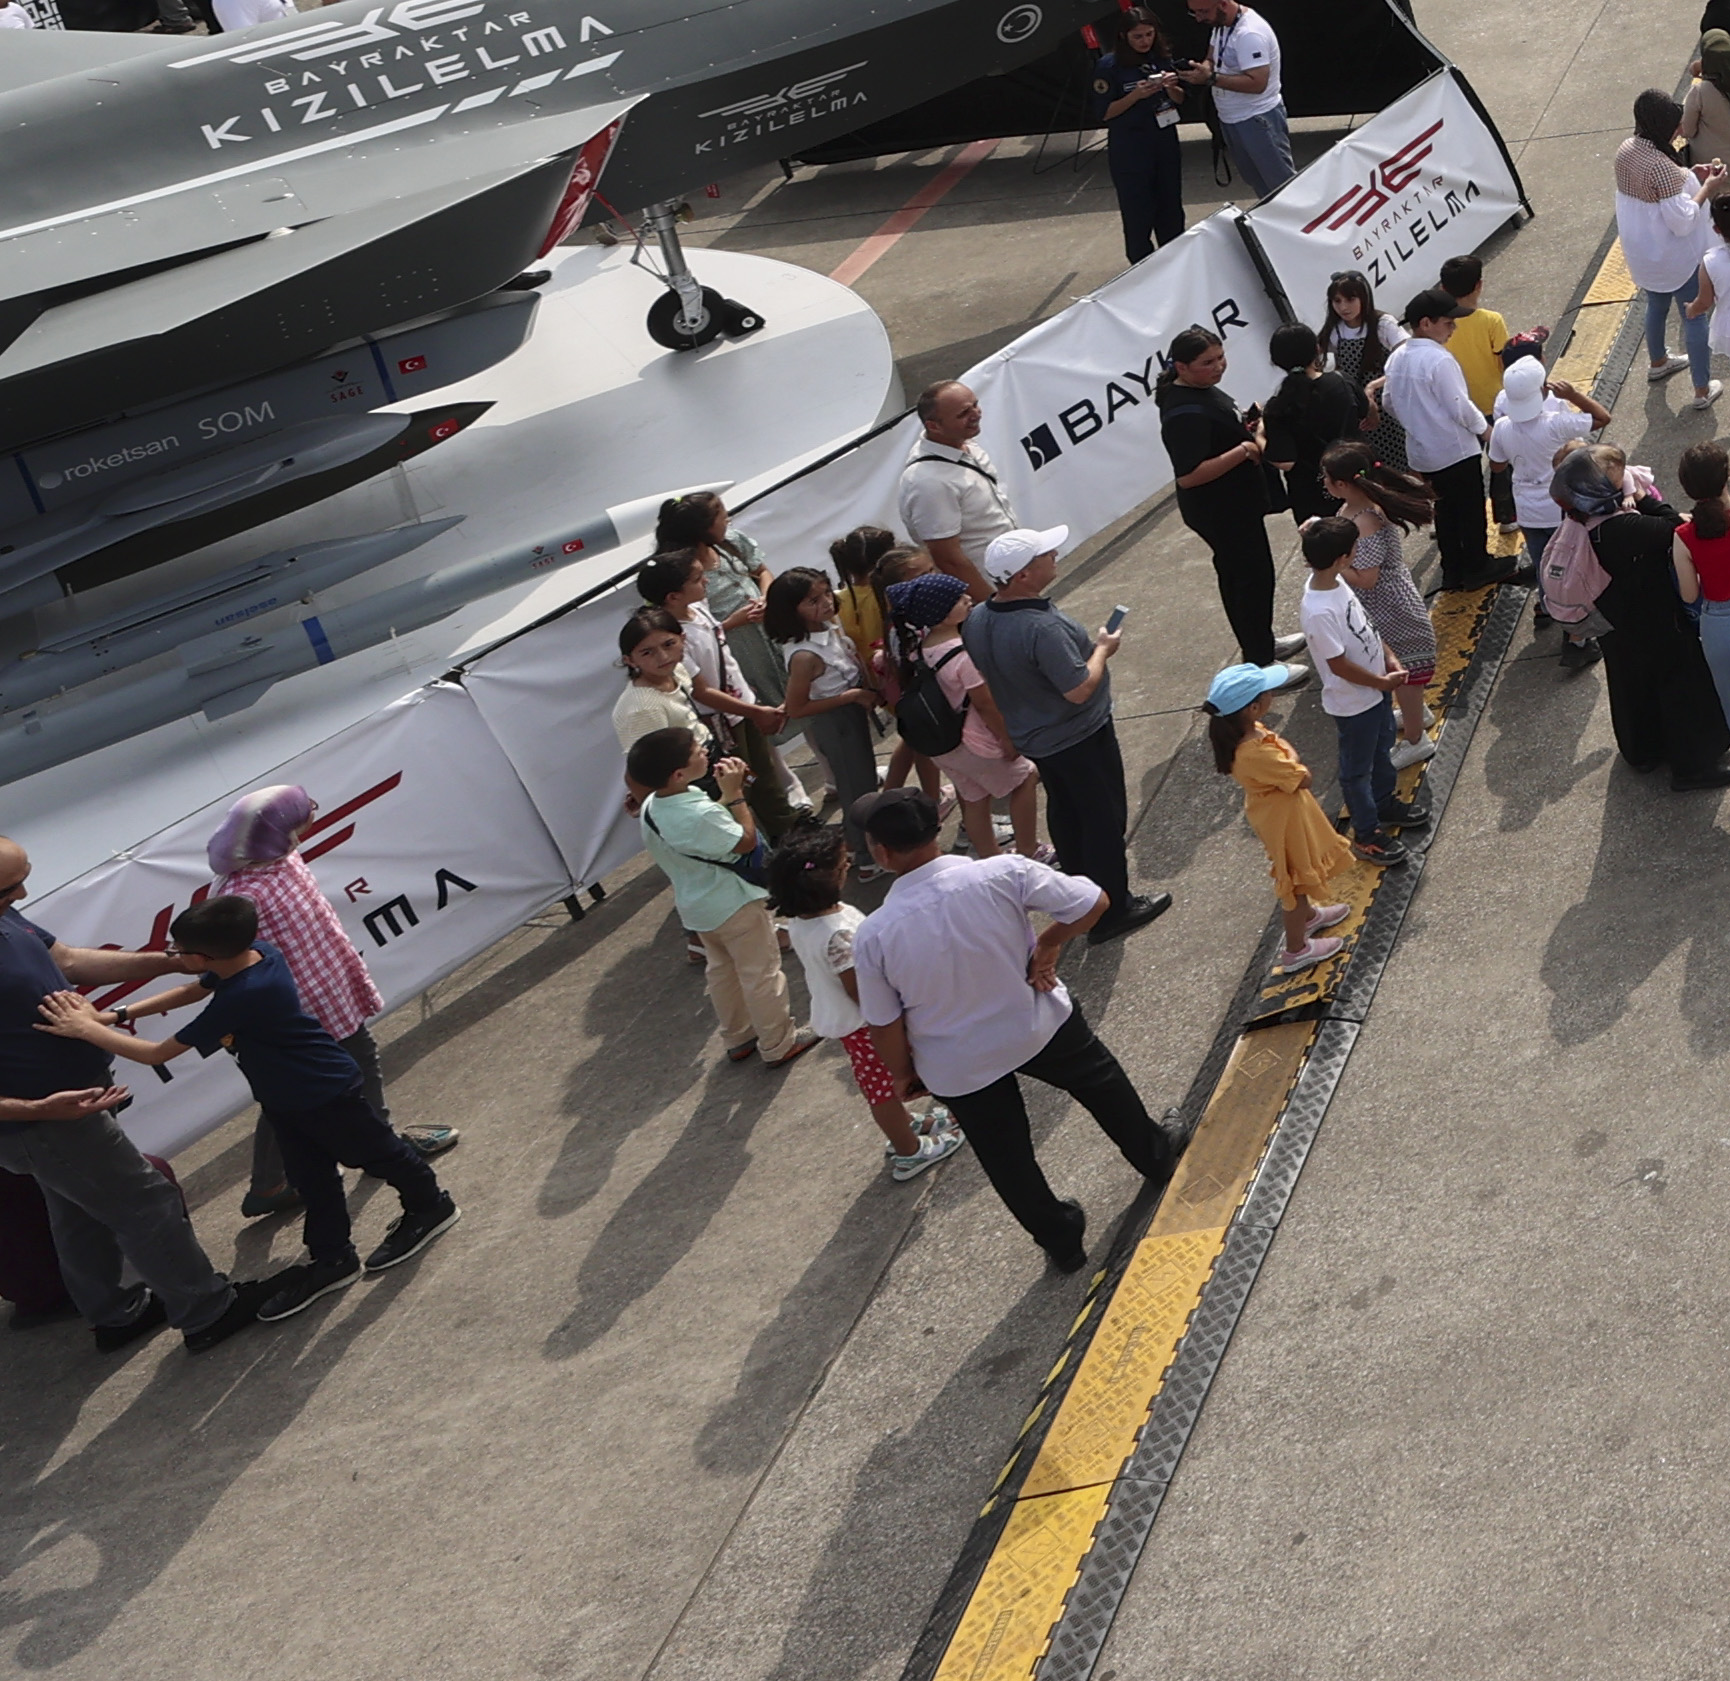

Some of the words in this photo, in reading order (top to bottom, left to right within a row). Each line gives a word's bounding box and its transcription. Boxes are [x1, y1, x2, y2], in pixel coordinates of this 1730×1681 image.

[200, 15, 614, 150] KIZILELMA
[264, 10, 532, 95] BAYRAKTAR
[695, 91, 868, 155] KIZILELMA
[727, 89, 842, 131] BAYRAKTAR
[1353, 174, 1444, 261] BAYRAKTAR
[1366, 180, 1482, 289] ZILELMA
[331, 385, 364, 404] SAGE
[1058, 298, 1250, 446] BAYR
[63, 432, 180, 485] roketsan
[197, 400, 276, 442] SOM
